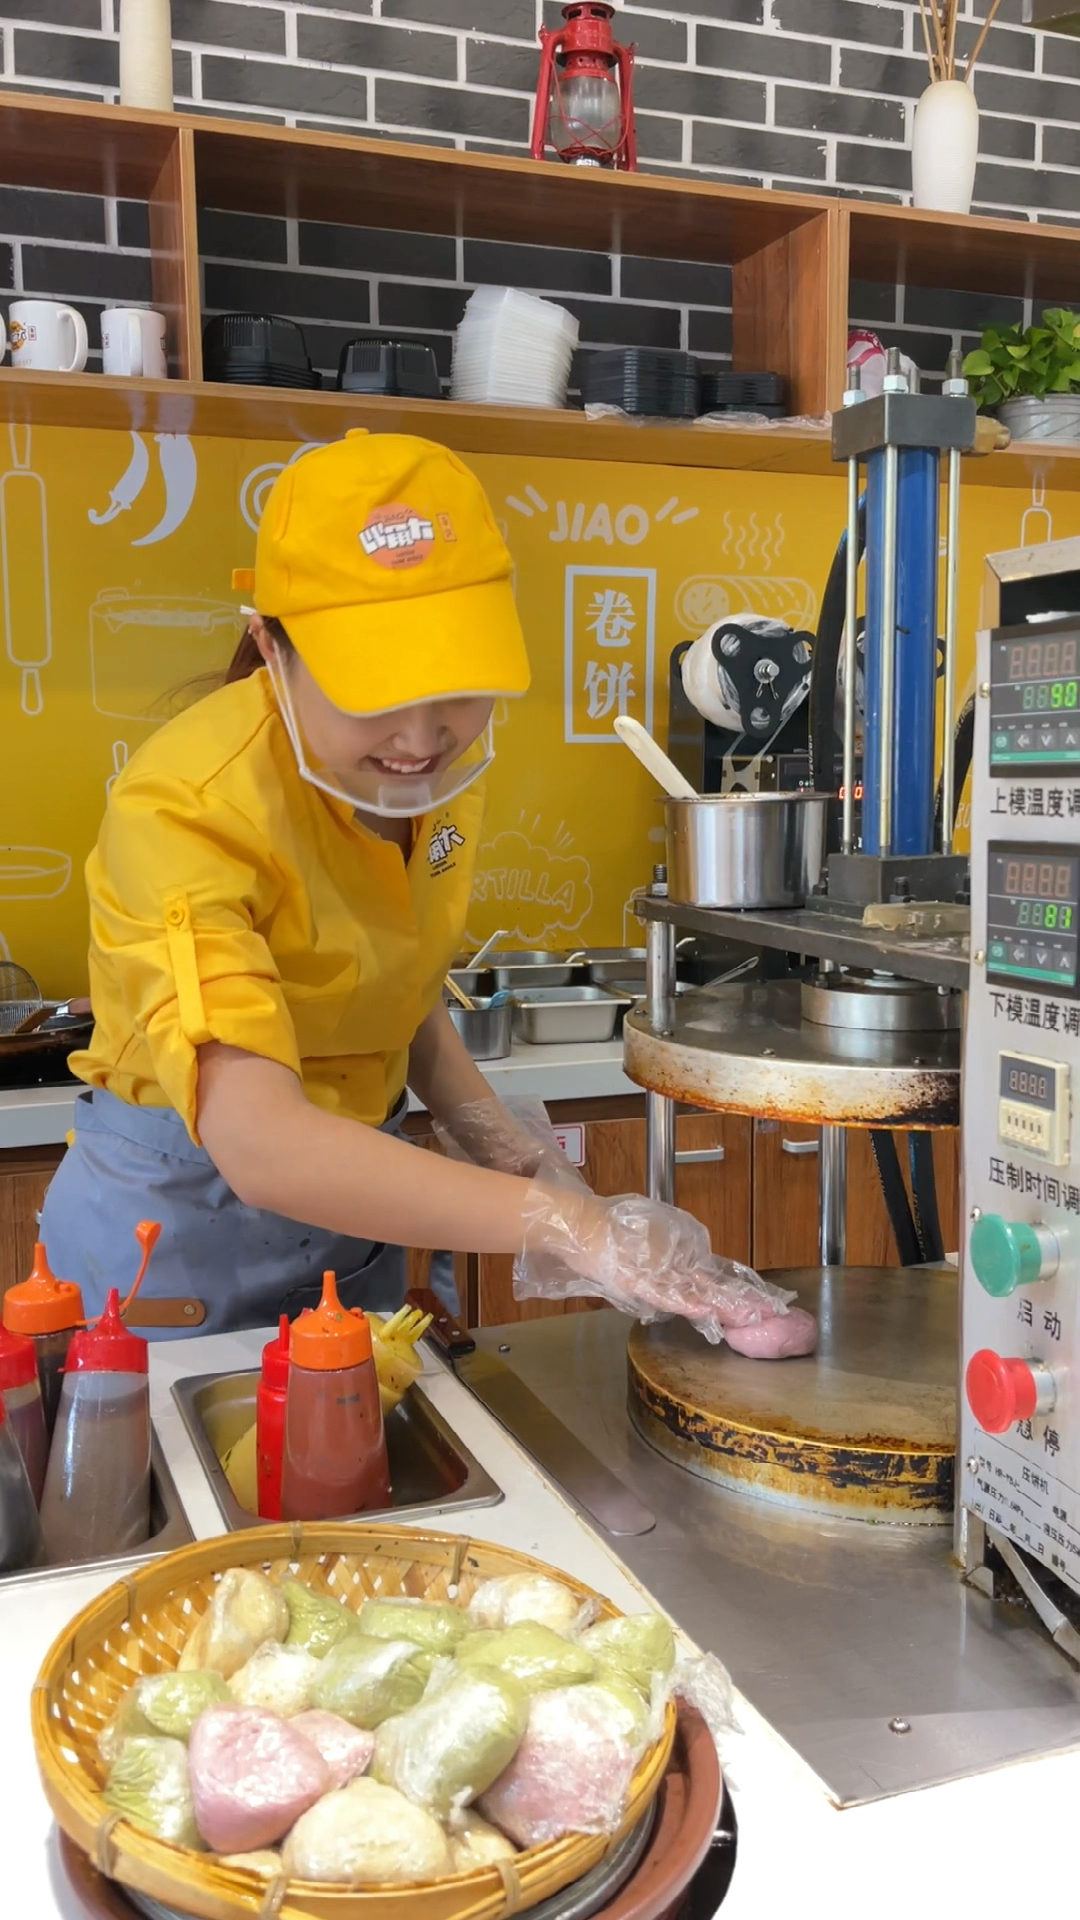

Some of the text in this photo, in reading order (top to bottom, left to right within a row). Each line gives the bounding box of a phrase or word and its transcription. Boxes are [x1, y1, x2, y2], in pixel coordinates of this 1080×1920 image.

[549, 501, 649, 545] JIAO
[583, 589, 637, 719] 卷饼
[1051, 682, 1078, 709] 90
[1044, 903, 1072, 929] 81
[988, 1156, 1080, 1215] 压制时间调
